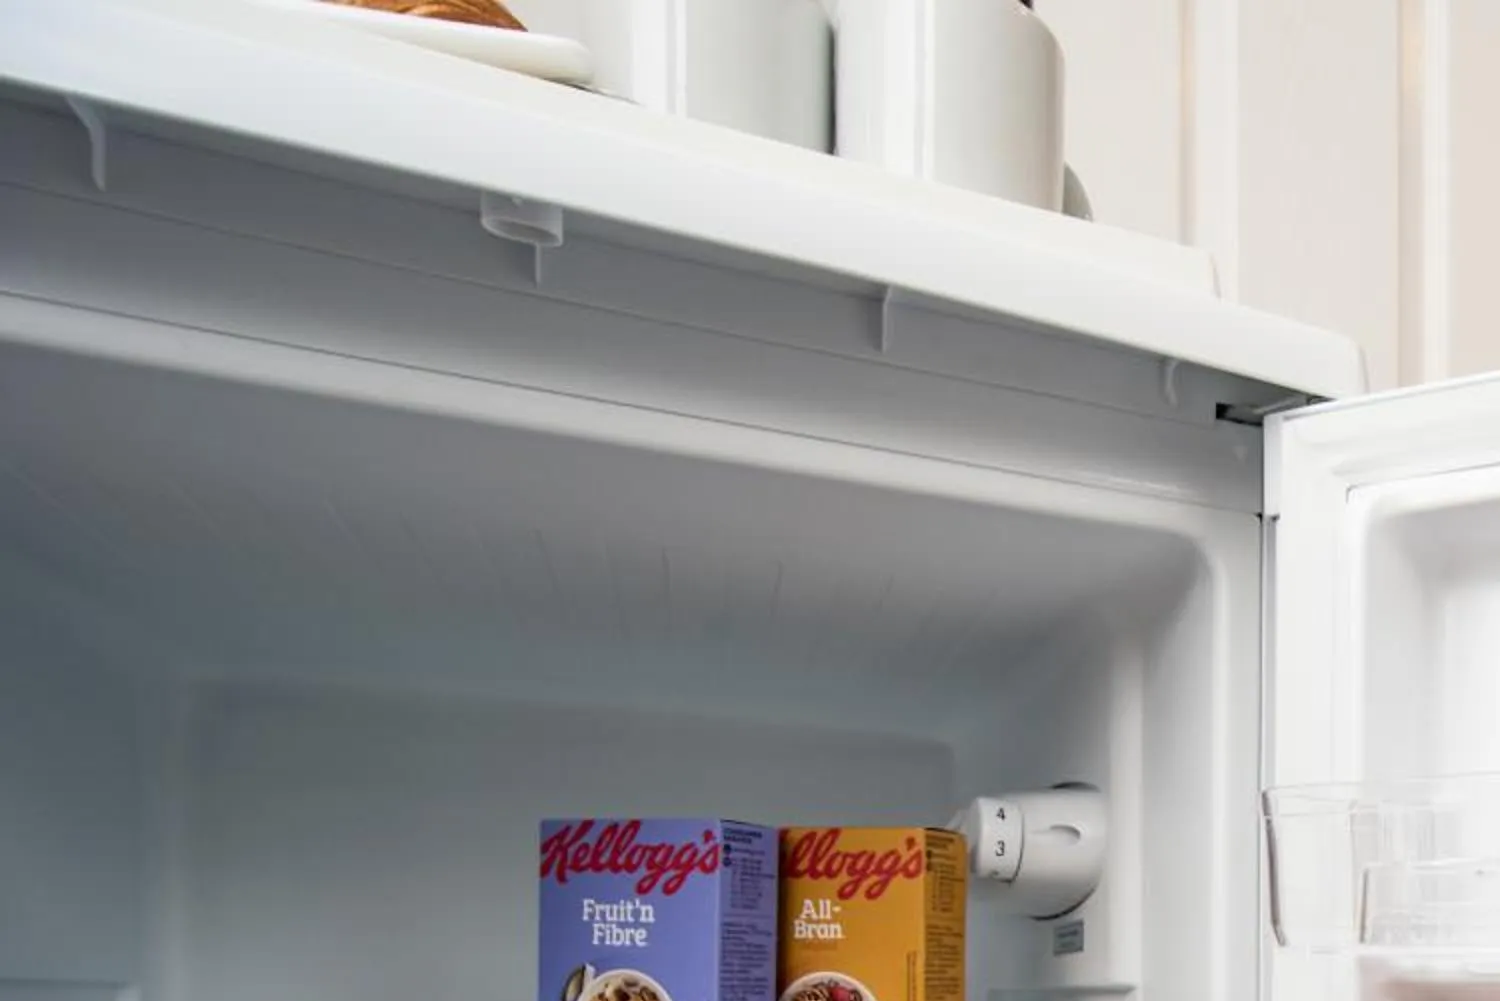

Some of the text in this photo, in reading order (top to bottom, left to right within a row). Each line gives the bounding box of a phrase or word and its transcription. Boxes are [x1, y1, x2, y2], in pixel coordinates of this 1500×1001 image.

[997, 807, 1005, 821] 4
[540, 819, 721, 896] Kellogg's
[995, 841, 1005, 857] 3
[800, 898, 842, 920] All-
[592, 922, 648, 947] Fibre
[793, 919, 843, 940] Bran
